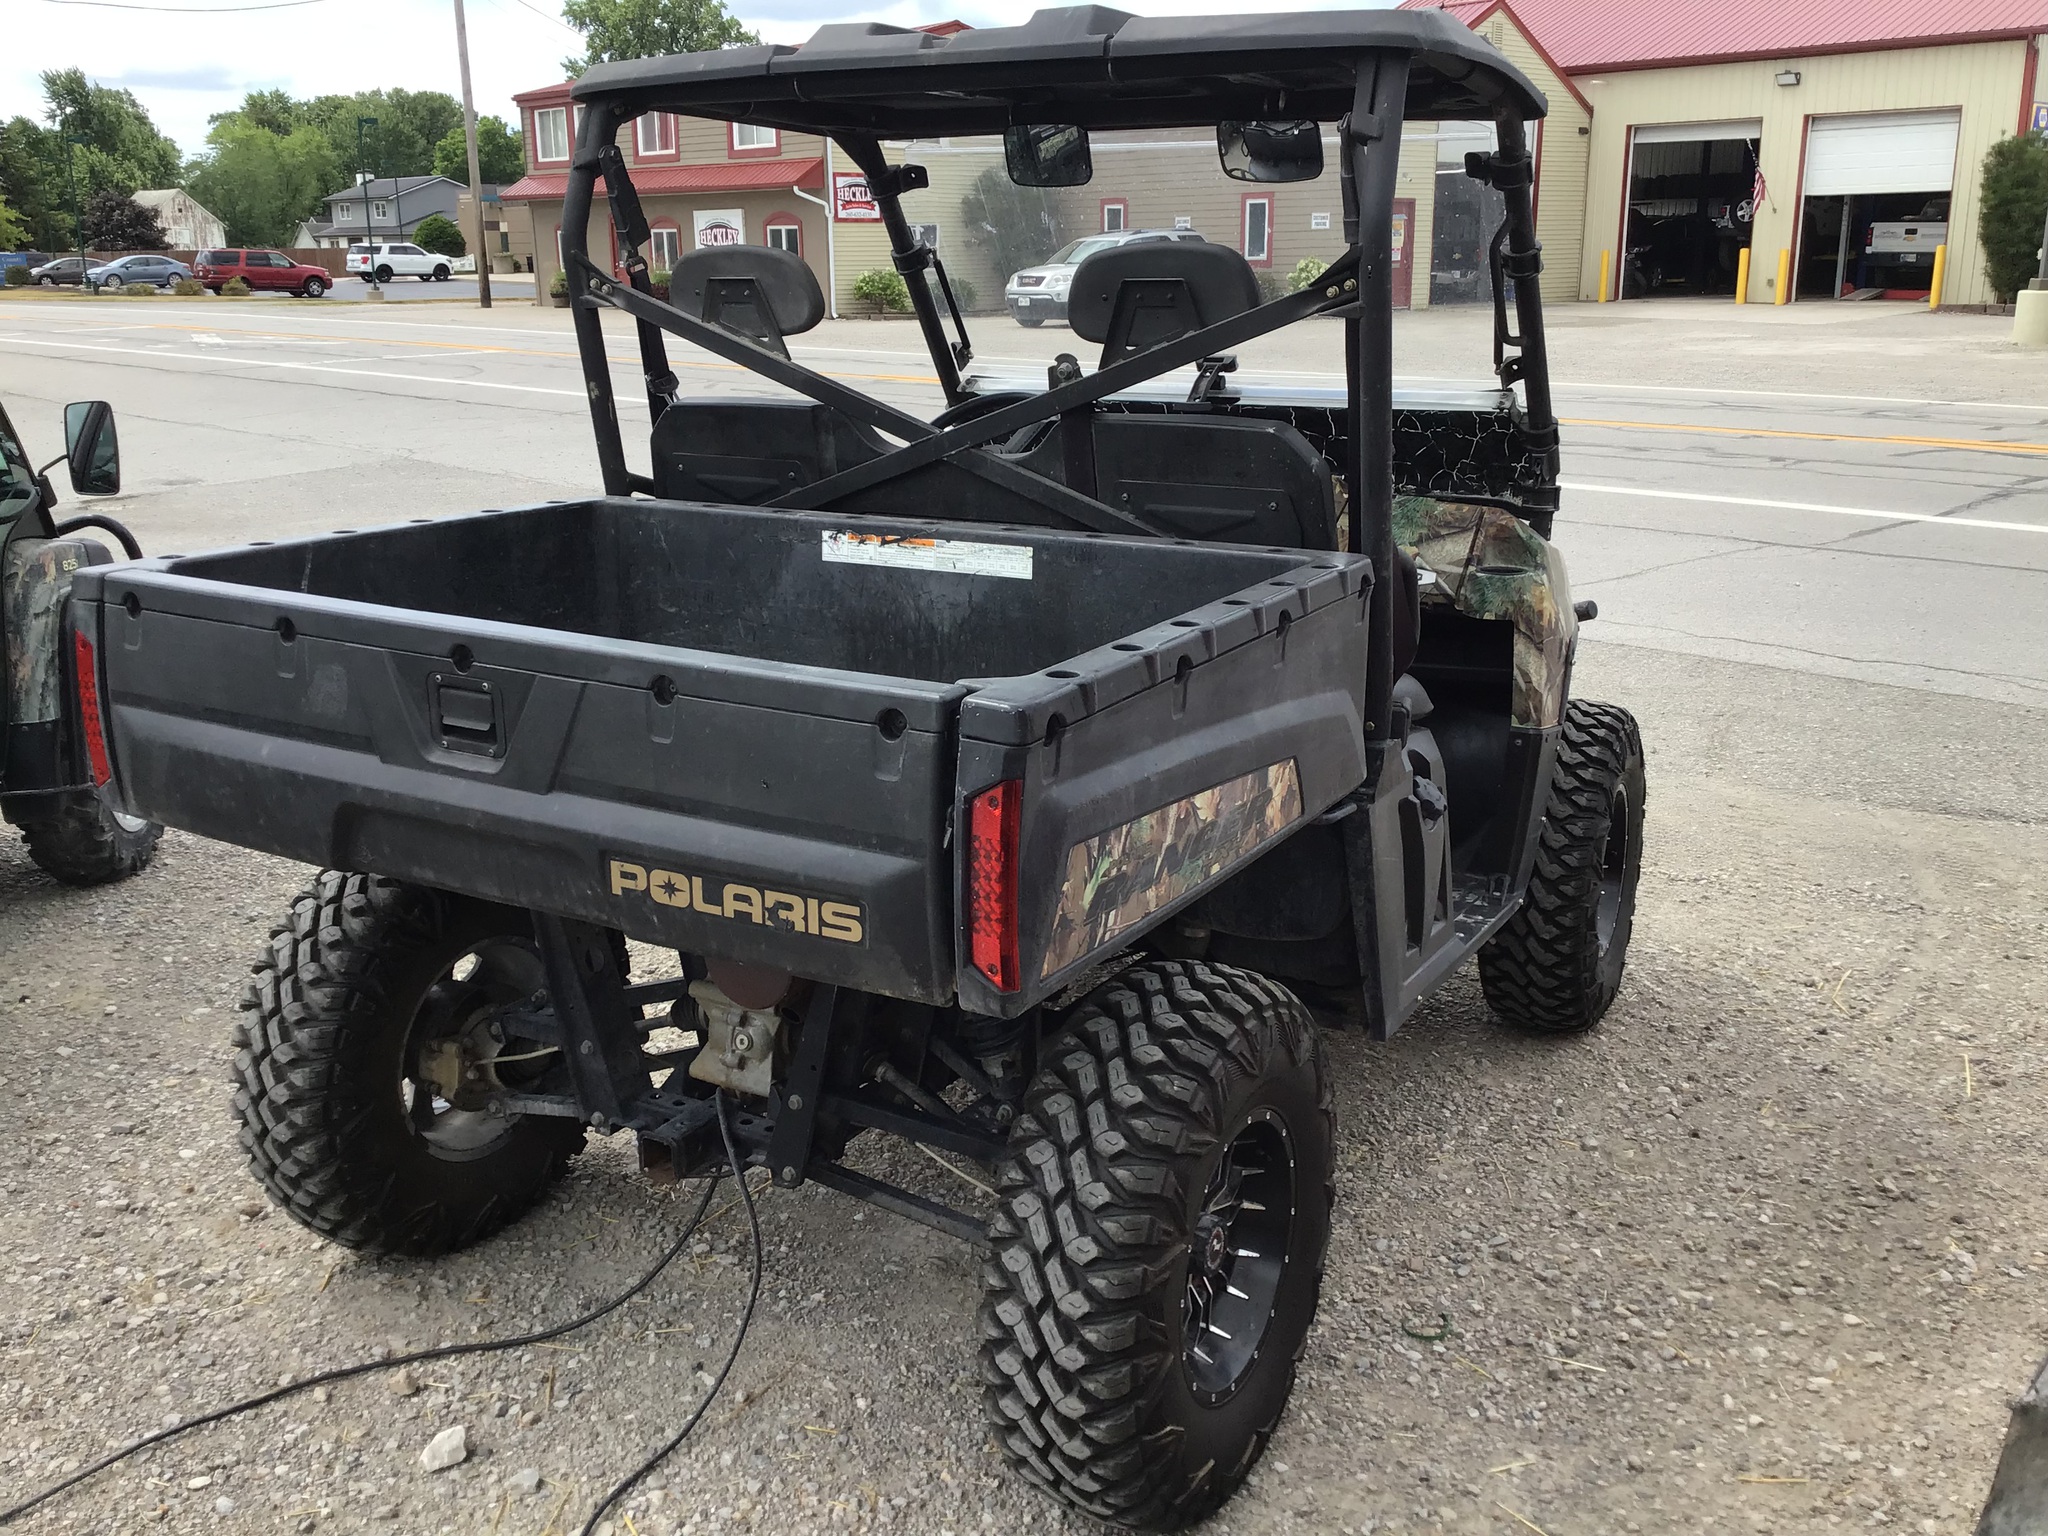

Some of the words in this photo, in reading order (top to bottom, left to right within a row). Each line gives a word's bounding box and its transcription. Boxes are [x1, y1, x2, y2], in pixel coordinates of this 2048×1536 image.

[837, 187, 873, 202] HECKLE
[700, 228, 738, 246] HECKLEY
[1083, 787, 1273, 926] RANGER
[609, 859, 864, 943] POLARIS
